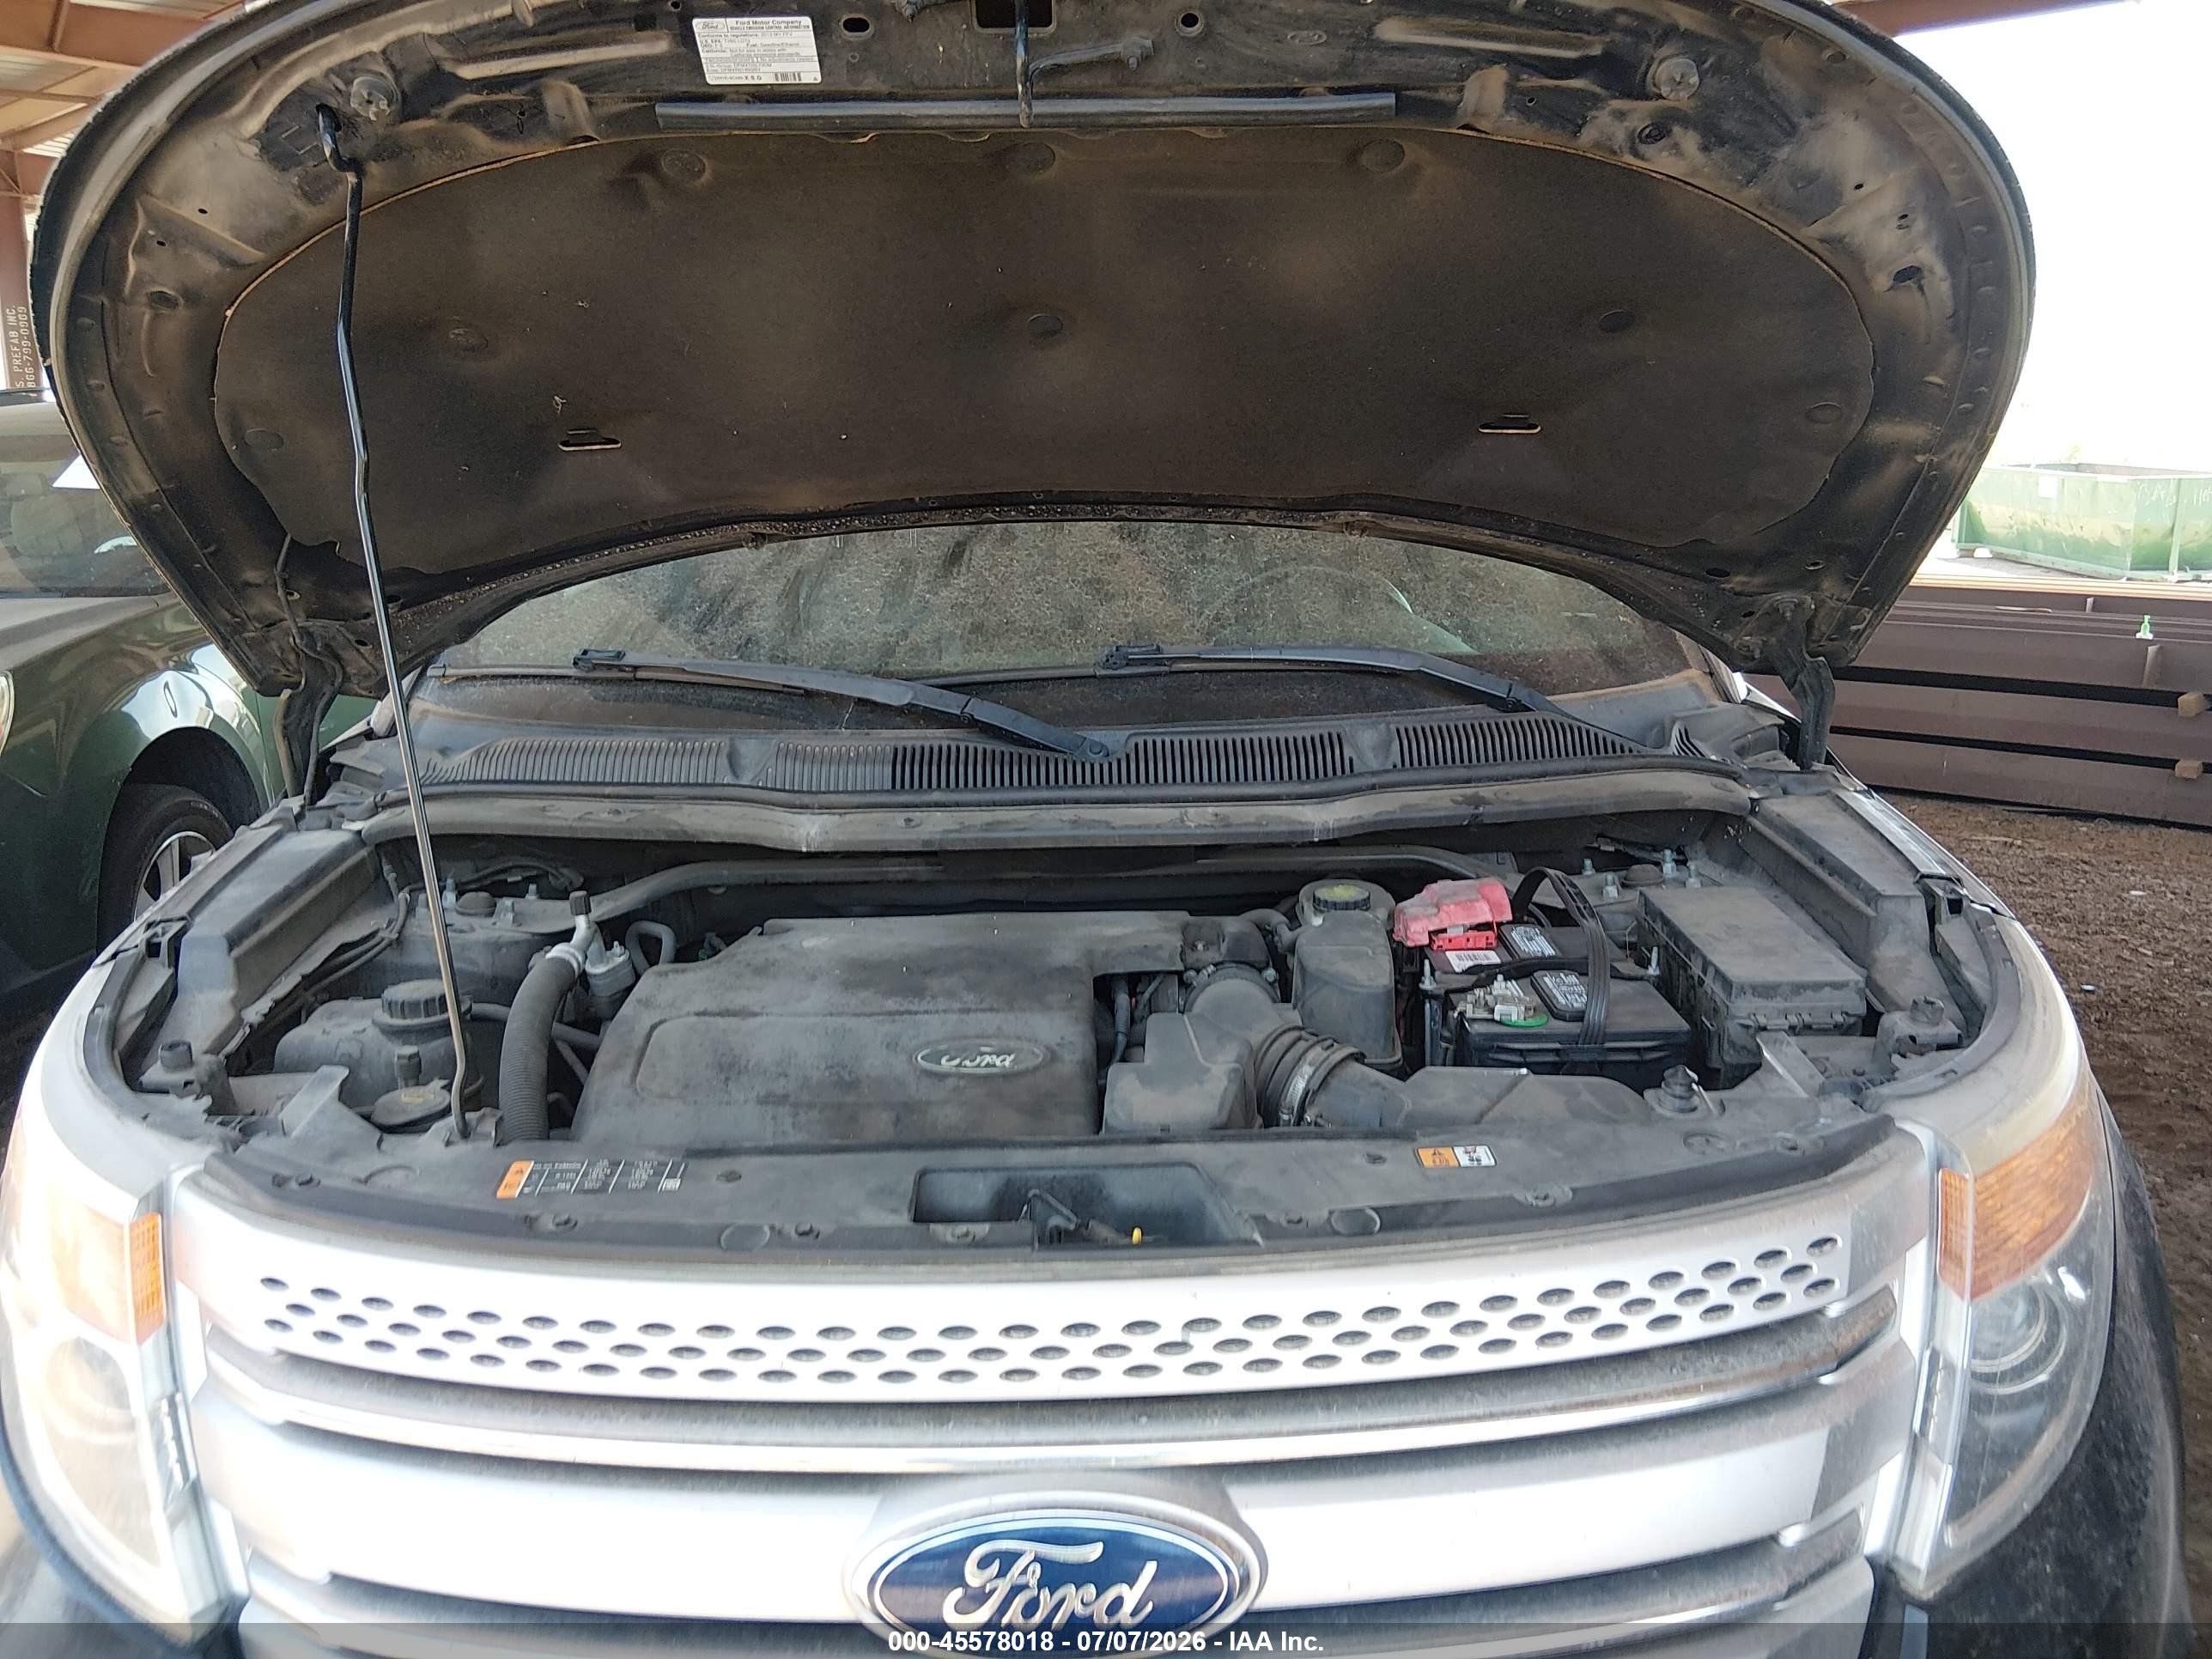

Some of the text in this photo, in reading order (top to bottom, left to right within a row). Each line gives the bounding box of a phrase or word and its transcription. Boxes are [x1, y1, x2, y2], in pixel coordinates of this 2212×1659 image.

[6, 305, 17, 326] INC.
[9, 331, 23, 372] PREFAB
[942, 1538, 1158, 1631] Ford
